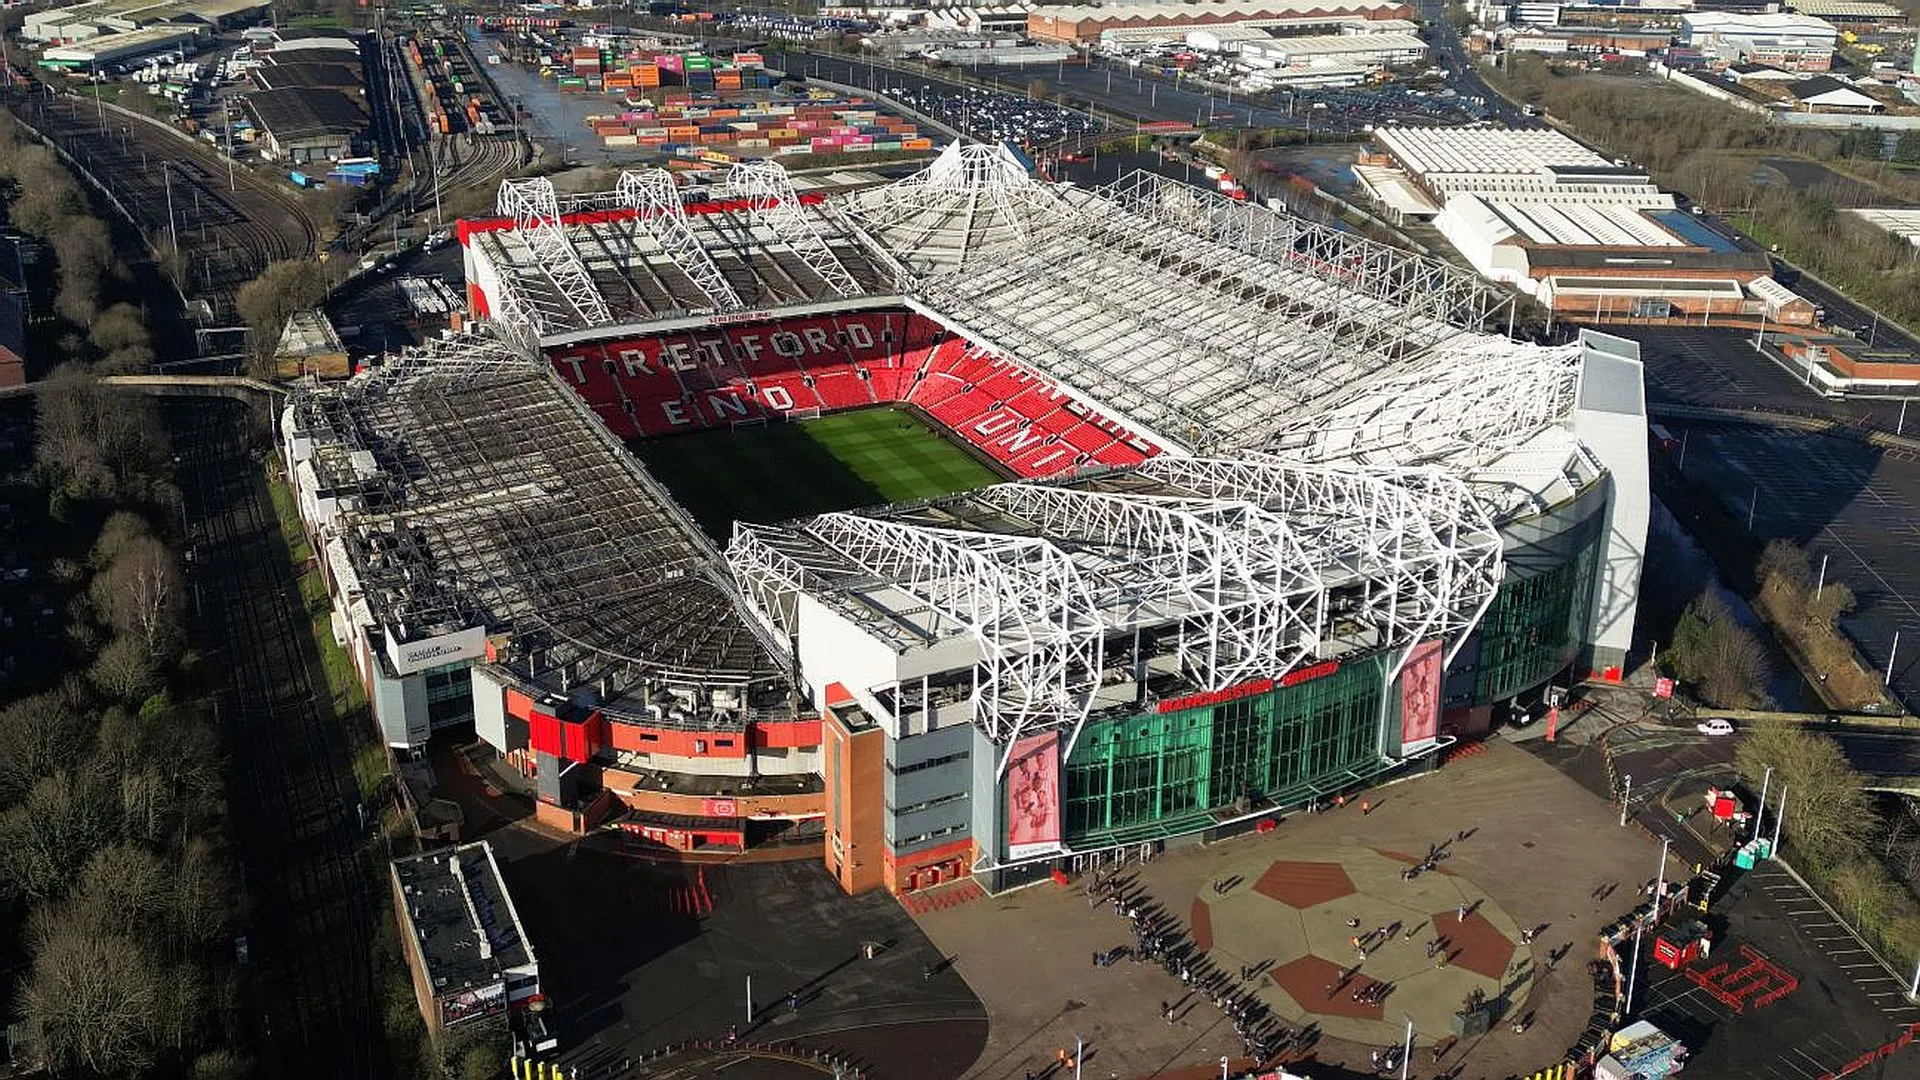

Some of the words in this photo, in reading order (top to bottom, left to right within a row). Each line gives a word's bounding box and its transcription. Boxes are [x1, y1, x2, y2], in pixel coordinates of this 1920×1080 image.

[561, 322, 875, 385] TRETFORD
[661, 385, 794, 426] END
[973, 411, 1066, 469] UNI
